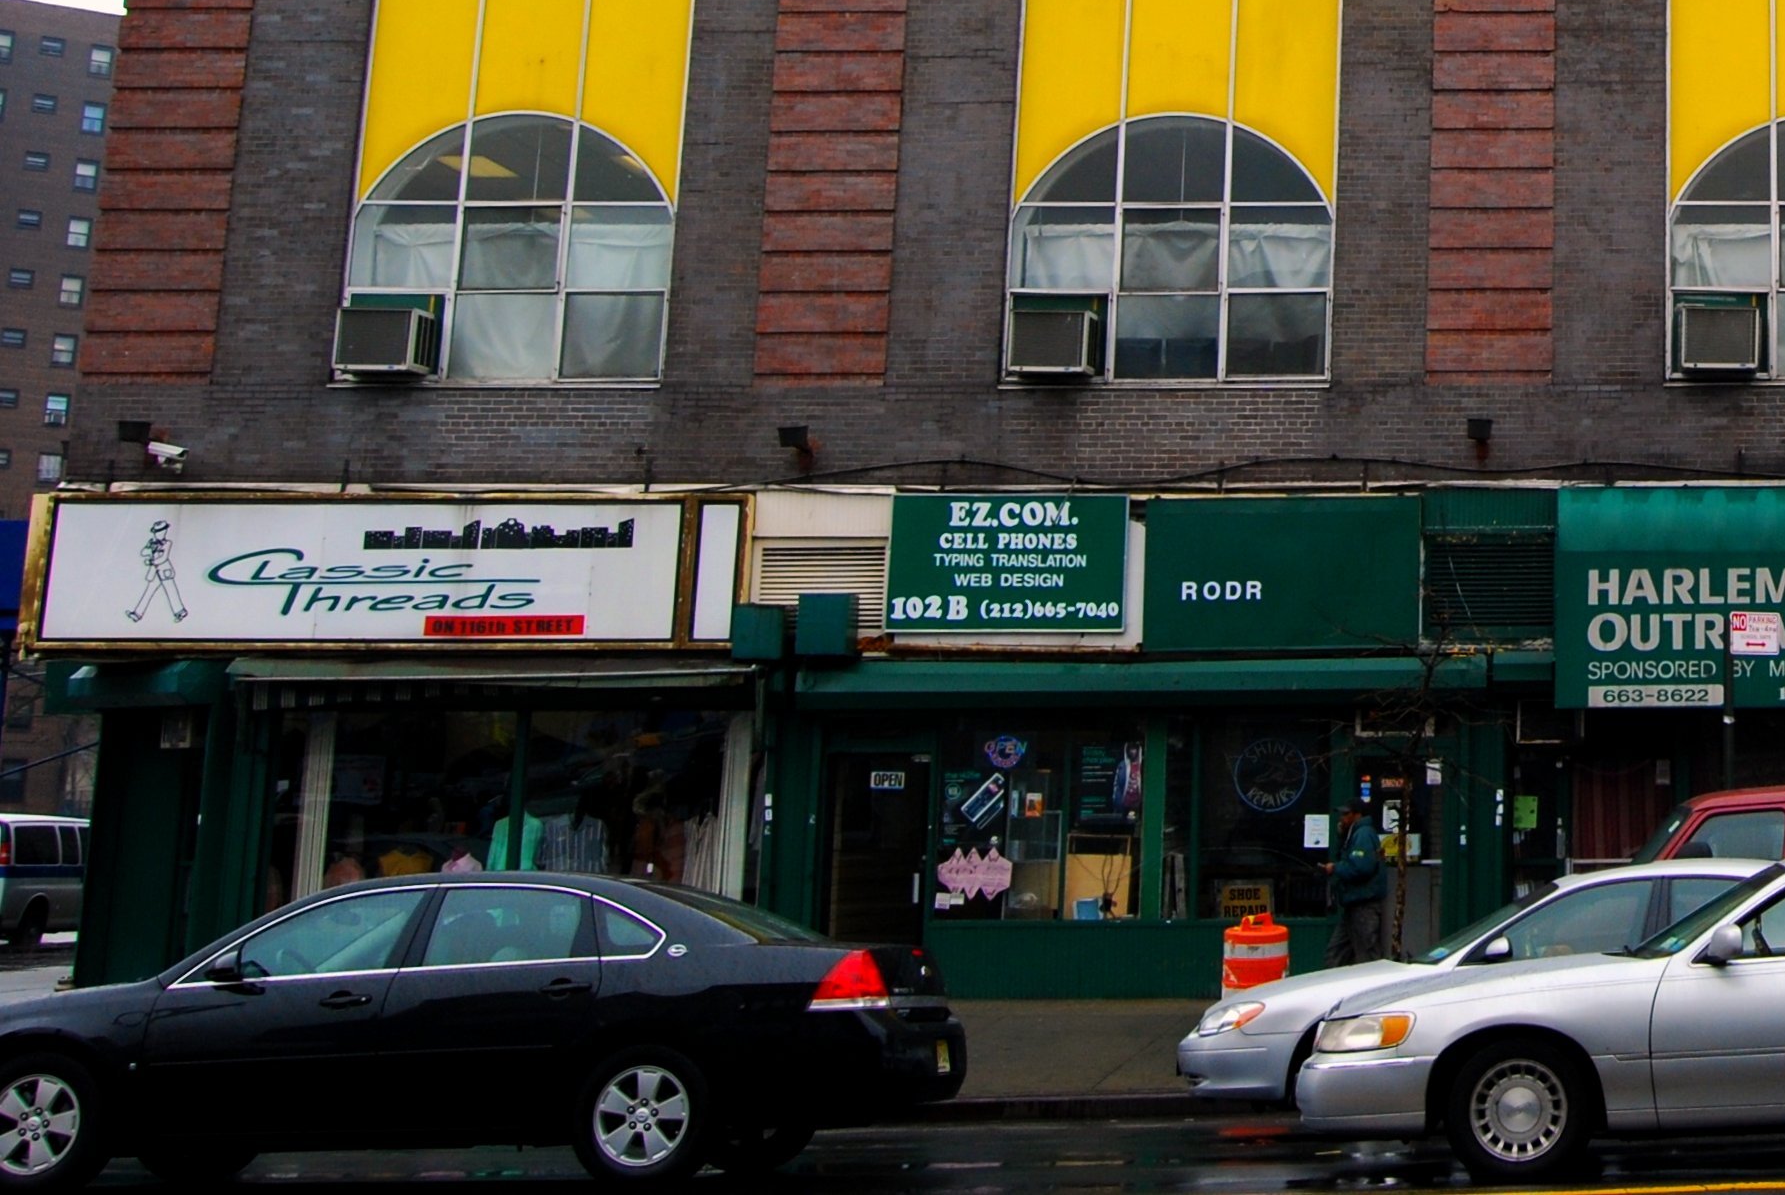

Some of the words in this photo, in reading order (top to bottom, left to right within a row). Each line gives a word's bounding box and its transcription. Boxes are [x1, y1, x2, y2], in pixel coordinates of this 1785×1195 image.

[948, 500, 1079, 527] EZ.COM.
[938, 533, 989, 549] CELL
[997, 533, 1078, 549] PHONES
[934, 554, 984, 568] TYPING
[991, 554, 1087, 568] TRANSLATION
[954, 574, 992, 587] WEB
[1000, 574, 1064, 587] DESIGN
[1181, 581, 1263, 601] RODR
[279, 582, 536, 617] Threads
[890, 595, 943, 620] 102
[946, 595, 969, 620] B
[980, 600, 1119, 619] (212)665-7040
[432, 620, 455, 634] ON
[512, 619, 574, 633] STREET
[1732, 615, 1746, 630] NO
[1588, 660, 1717, 680] SPONSORED
[1602, 689, 1709, 703] 663-8622
[874, 772, 902, 787] OPEN
[1229, 888, 1261, 900] SHOE
